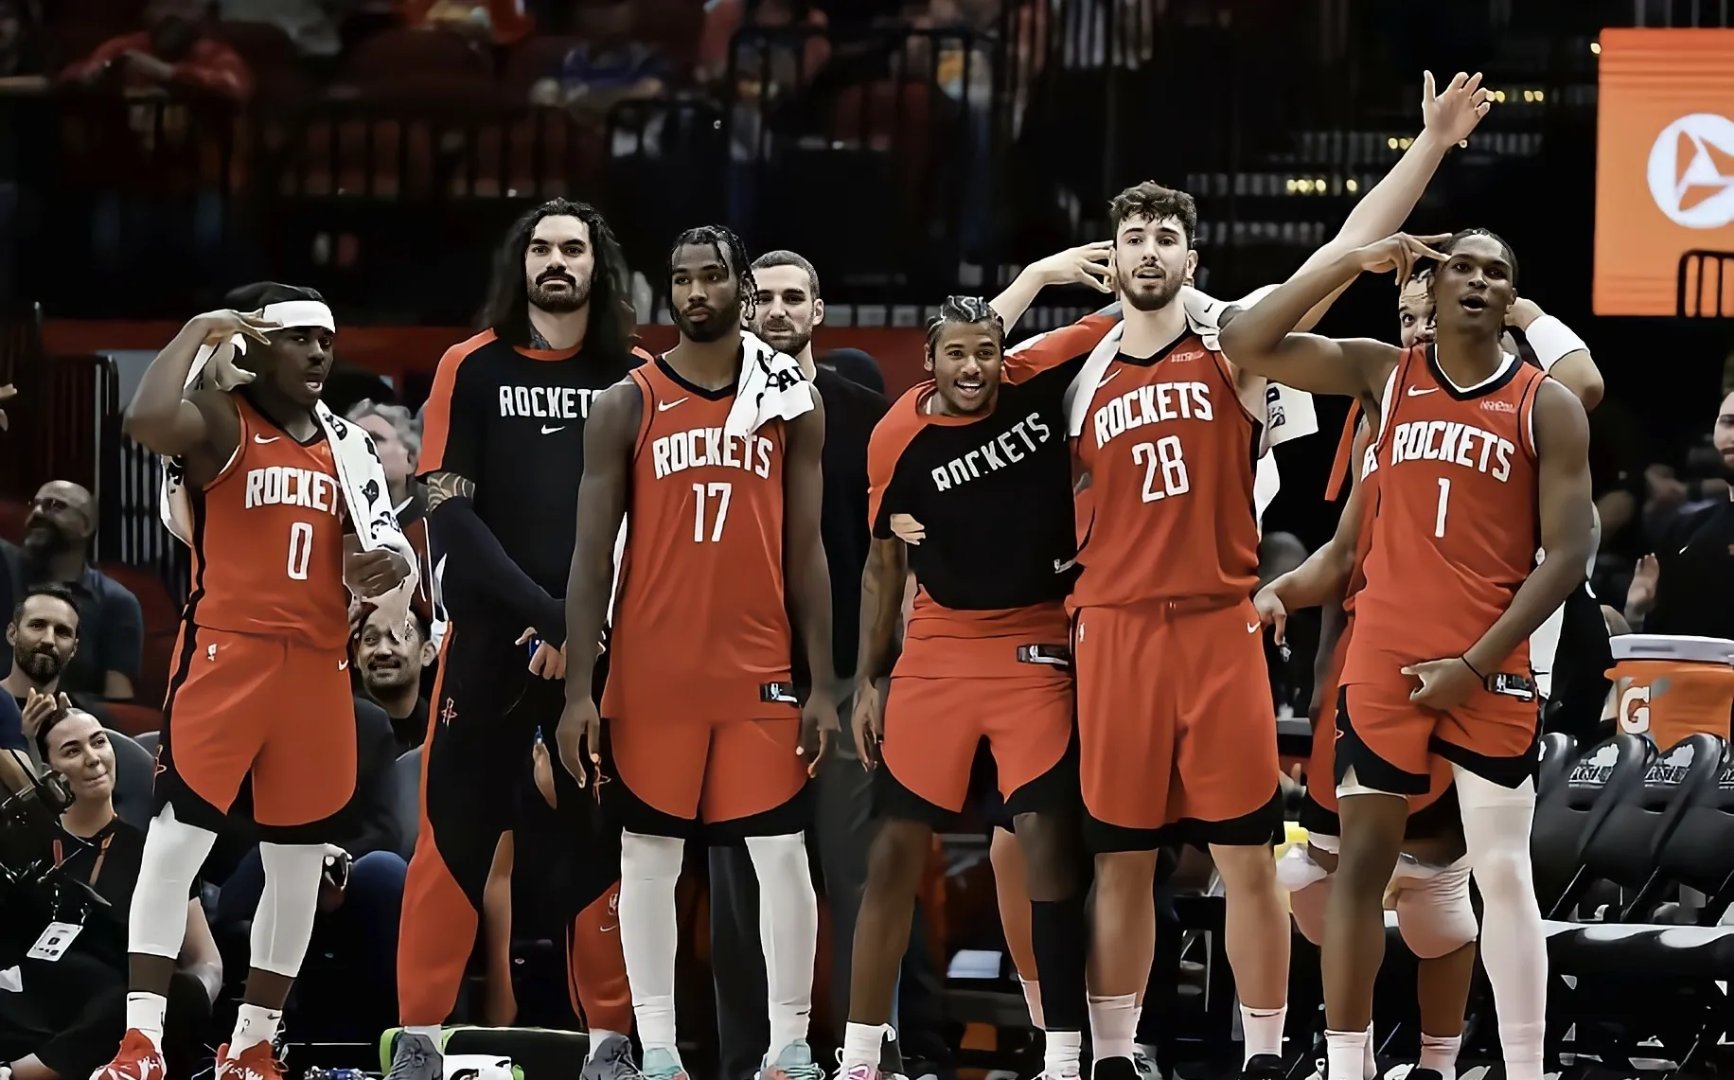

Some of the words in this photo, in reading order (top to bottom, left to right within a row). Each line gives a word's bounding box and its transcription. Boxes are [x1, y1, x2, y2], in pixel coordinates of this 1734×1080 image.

[499, 385, 604, 419] ROCKET
[1094, 381, 1214, 450] ROCKETS
[652, 427, 773, 480] ROCKETS
[1131, 435, 1190, 504] 28
[1391, 420, 1515, 483] ROCKETS
[692, 482, 732, 543] 17
[1434, 477, 1451, 538] 1
[287, 521, 313, 580] 0
[1620, 686, 1650, 734] G
